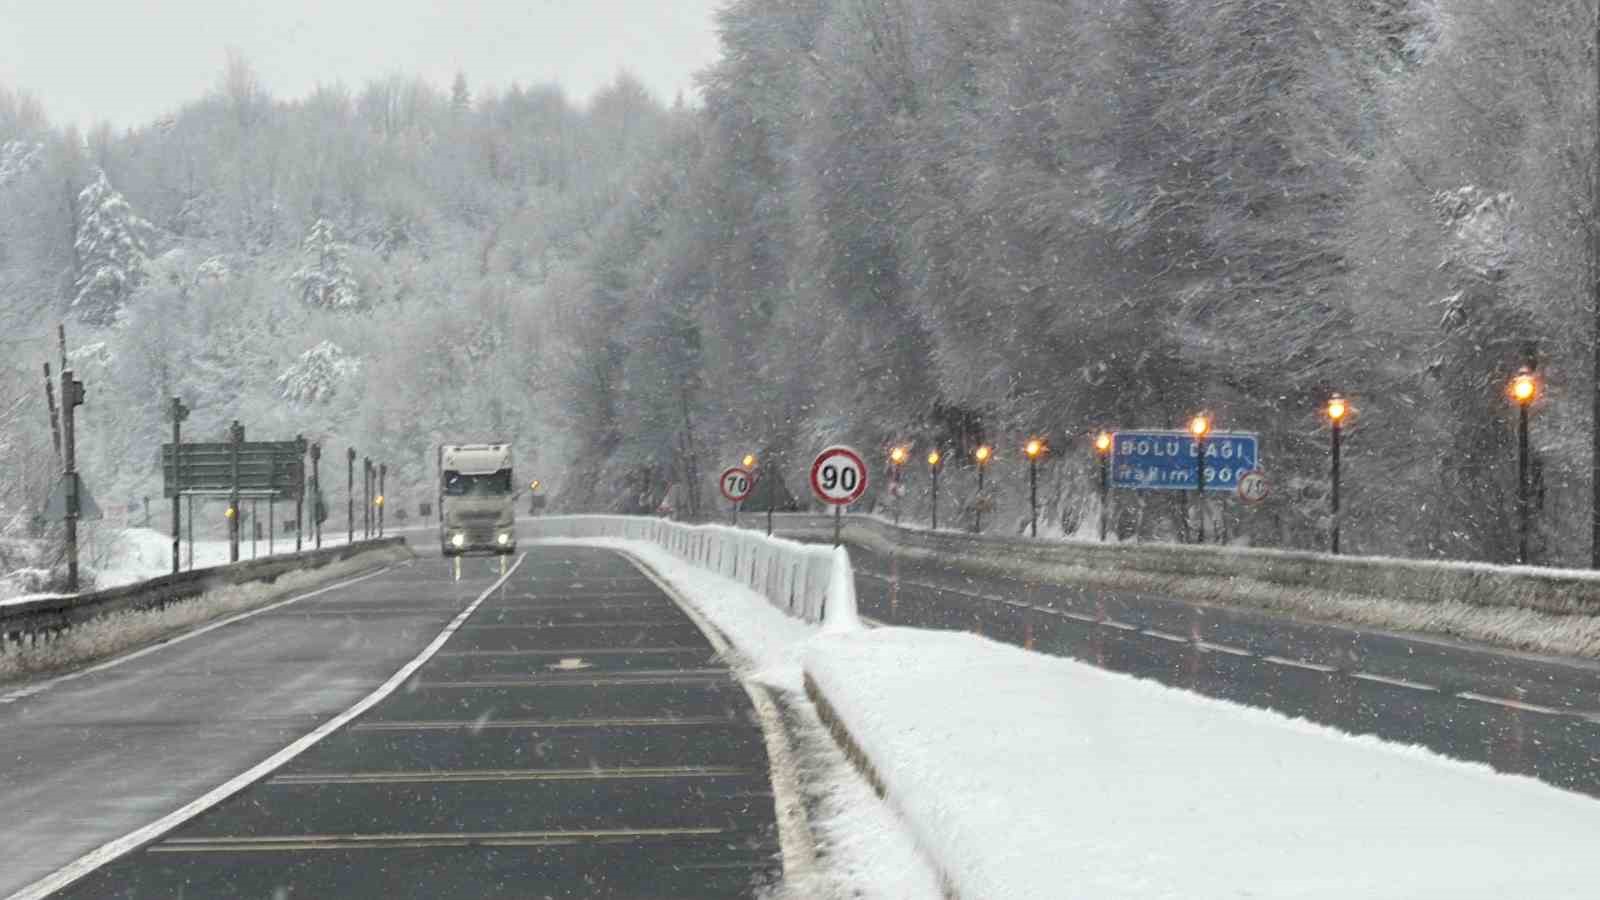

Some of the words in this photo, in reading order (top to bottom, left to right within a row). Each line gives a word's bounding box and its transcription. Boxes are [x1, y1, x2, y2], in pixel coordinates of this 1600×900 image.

[1120, 441, 1180, 457] BOLU
[728, 477, 748, 492] 70
[822, 465, 857, 491] 90
